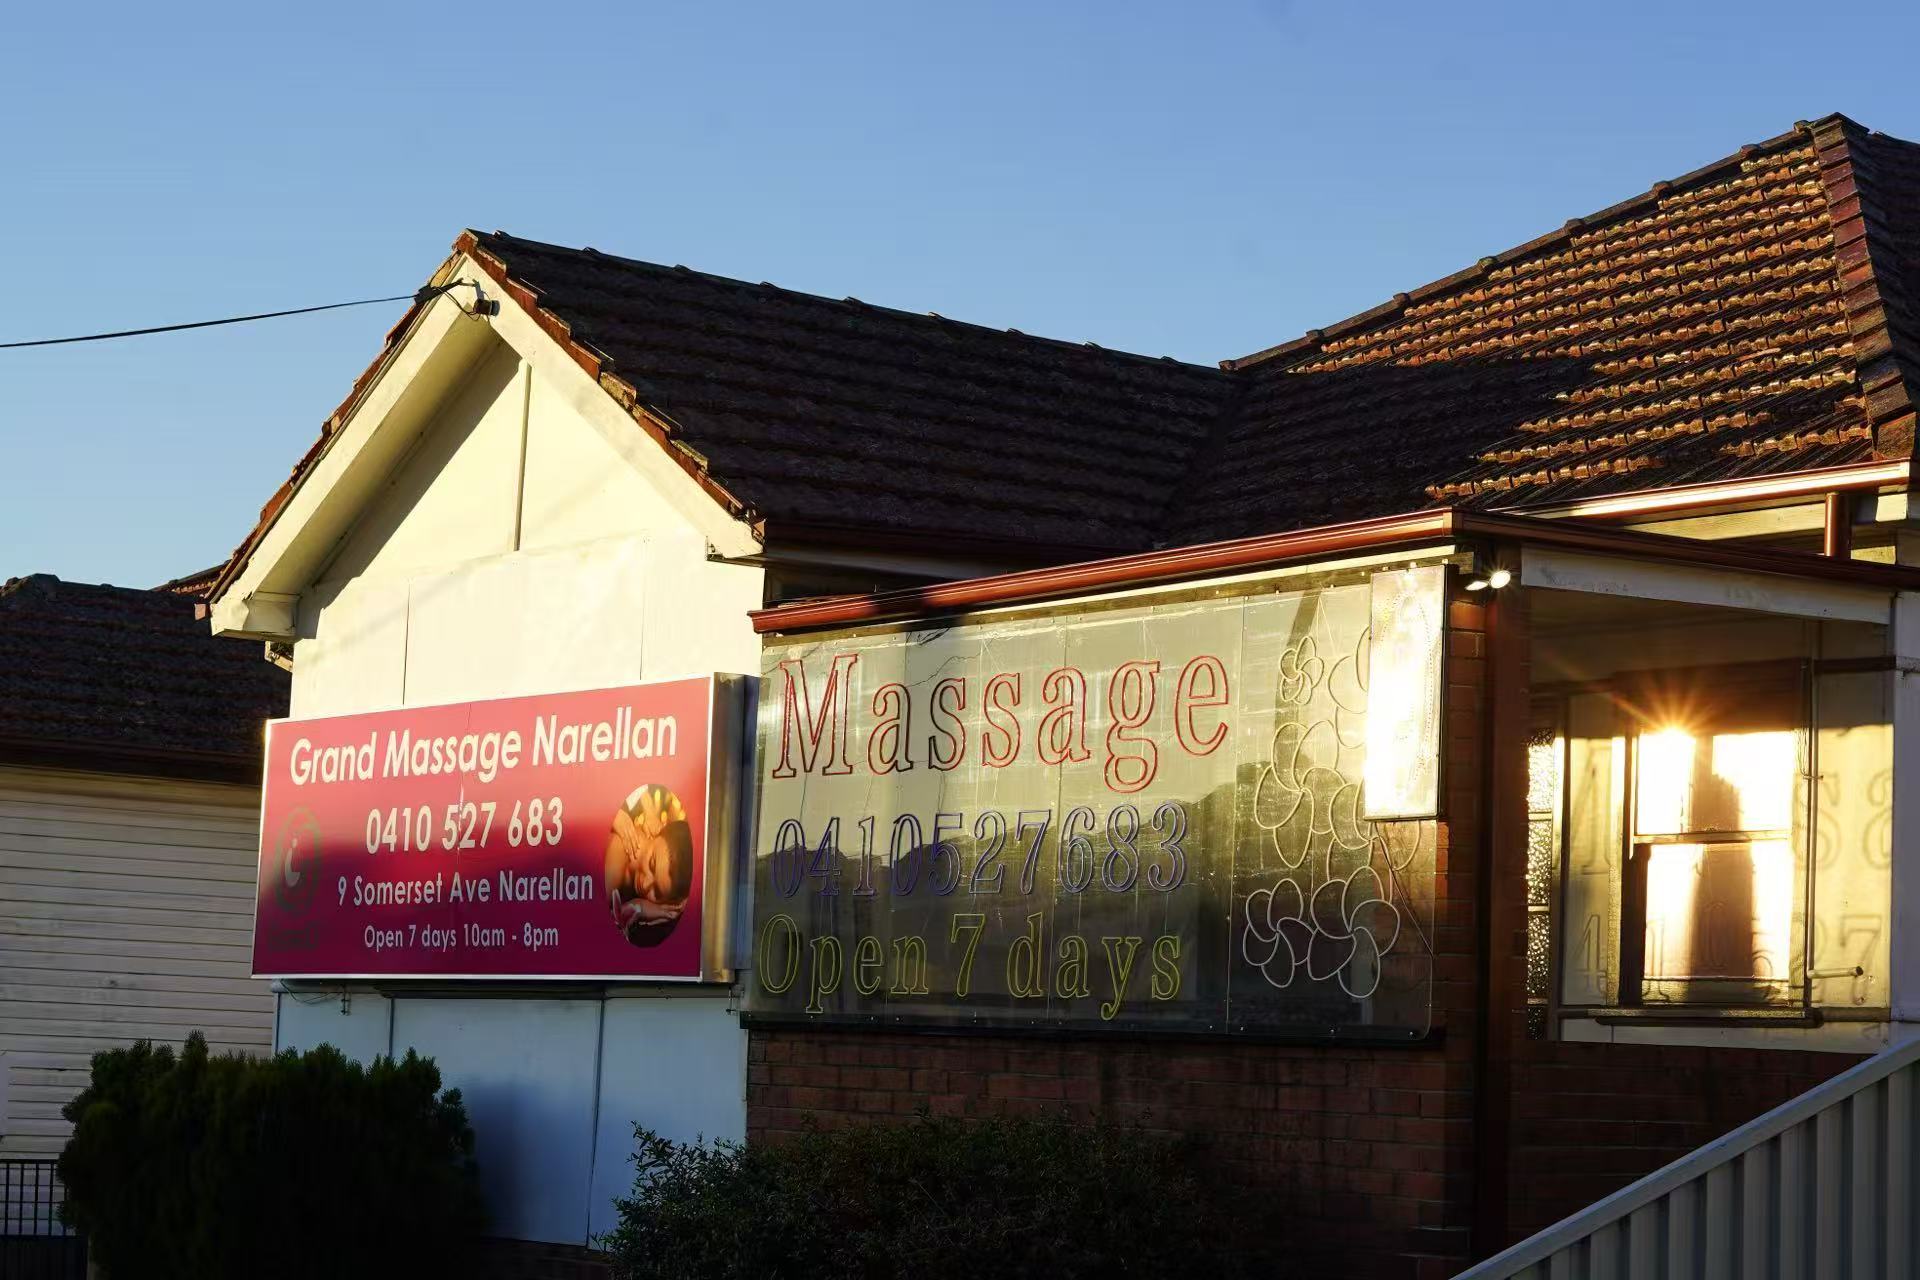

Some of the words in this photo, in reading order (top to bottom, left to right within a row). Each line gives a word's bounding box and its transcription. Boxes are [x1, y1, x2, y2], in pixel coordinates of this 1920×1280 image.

[289, 731, 374, 785] Grand
[383, 729, 521, 783] Massage
[533, 708, 677, 766] Narellan
[772, 653, 1229, 793] Massage
[366, 805, 431, 854] 0410
[442, 800, 496, 851] 527
[507, 797, 563, 847] 683
[771, 800, 1188, 897] 0410527683
[338, 876, 348, 906] 9
[353, 872, 443, 905] Somerset
[450, 871, 491, 902] Ave
[499, 868, 593, 901] Narellan
[364, 925, 403, 952] Open
[408, 925, 416, 947] 7
[421, 924, 457, 952] days
[463, 923, 505, 947] 10am
[523, 922, 559, 951] 8pm
[759, 913, 929, 1014] Open
[950, 913, 987, 997] 7
[1007, 911, 1182, 1021] days
